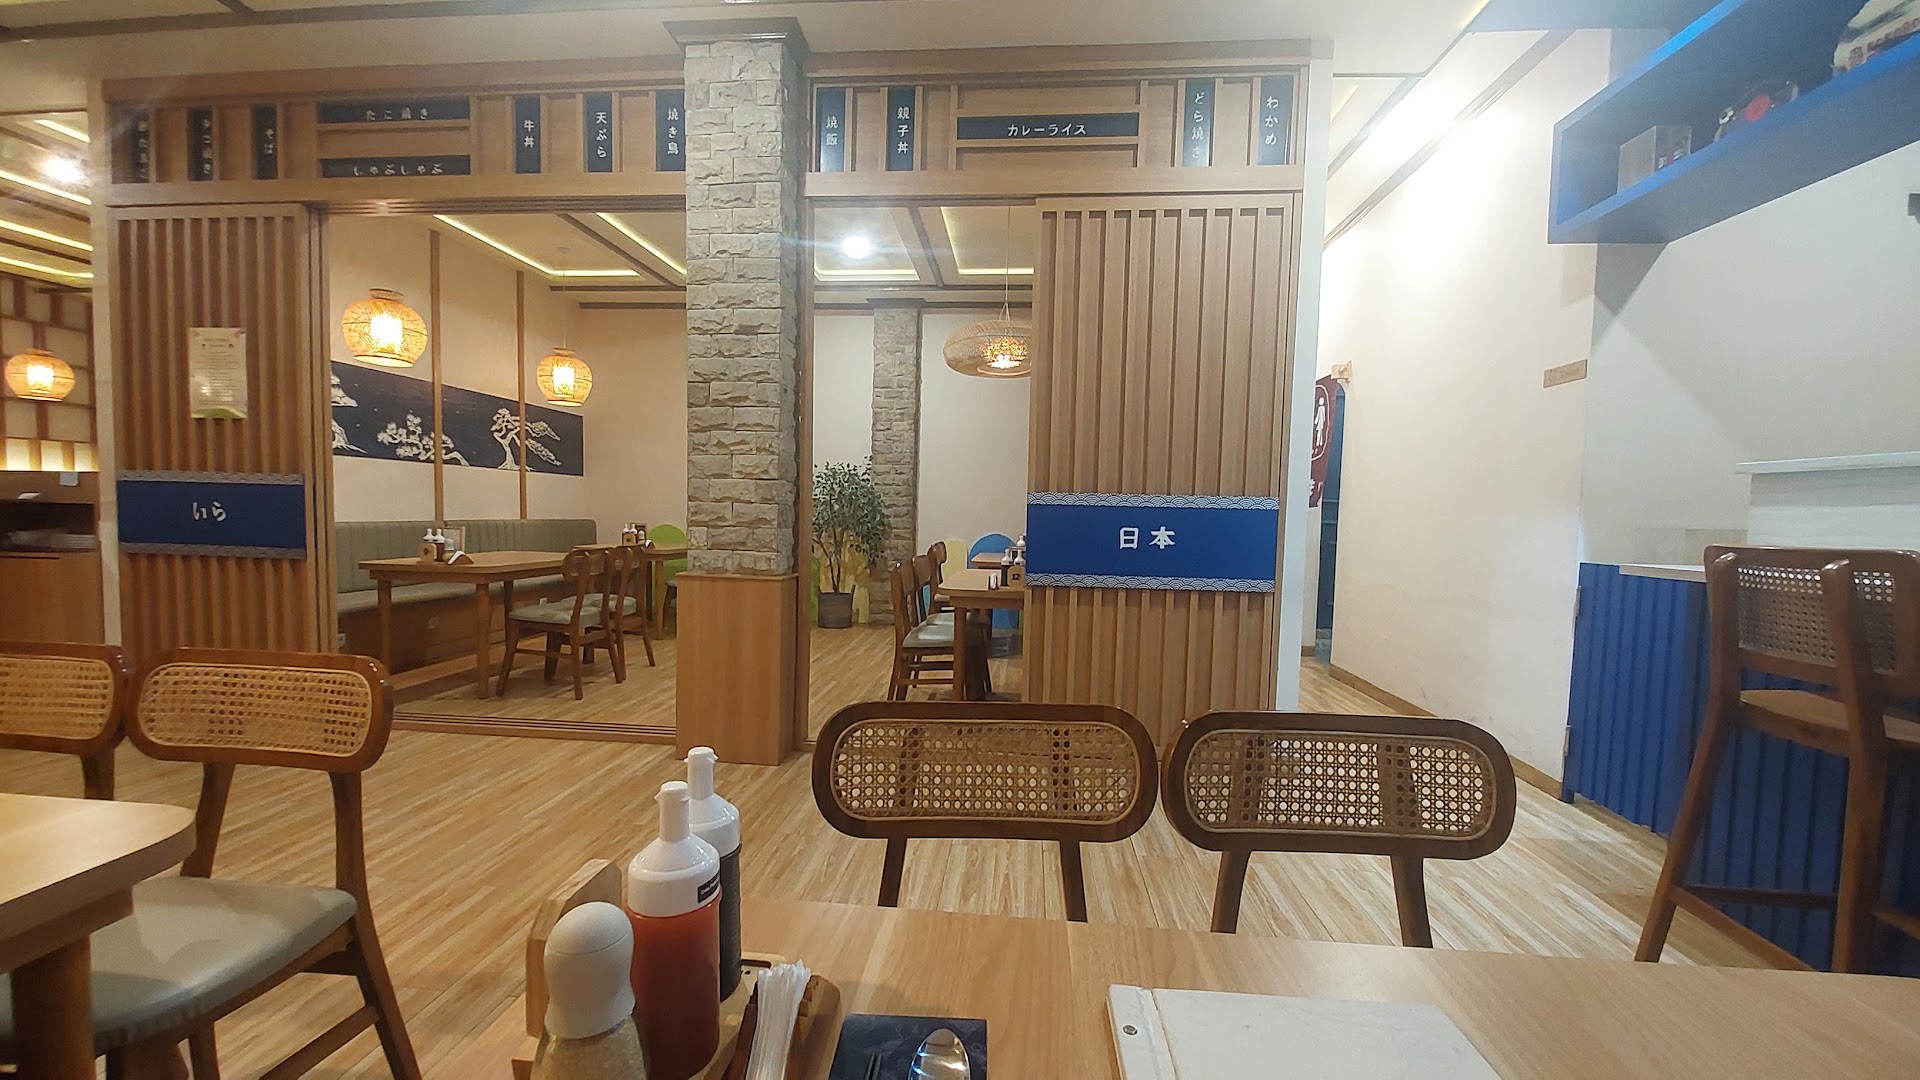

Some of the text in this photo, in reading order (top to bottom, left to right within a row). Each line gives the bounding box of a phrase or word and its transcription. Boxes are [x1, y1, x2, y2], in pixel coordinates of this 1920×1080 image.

[523, 119, 535, 148] 牛丼
[596, 111, 608, 158] 天ぷら
[667, 107, 679, 155] 焼き鳥
[826, 115, 838, 146] 焼飯
[897, 106, 910, 154] 親子丼
[1007, 122, 1087, 137] カレーライス
[1264, 95, 1279, 146] わかめ
[192, 502, 227, 522] いら
[1118, 525, 1176, 550] 日本
[1012, 573, 1021, 581] 12
